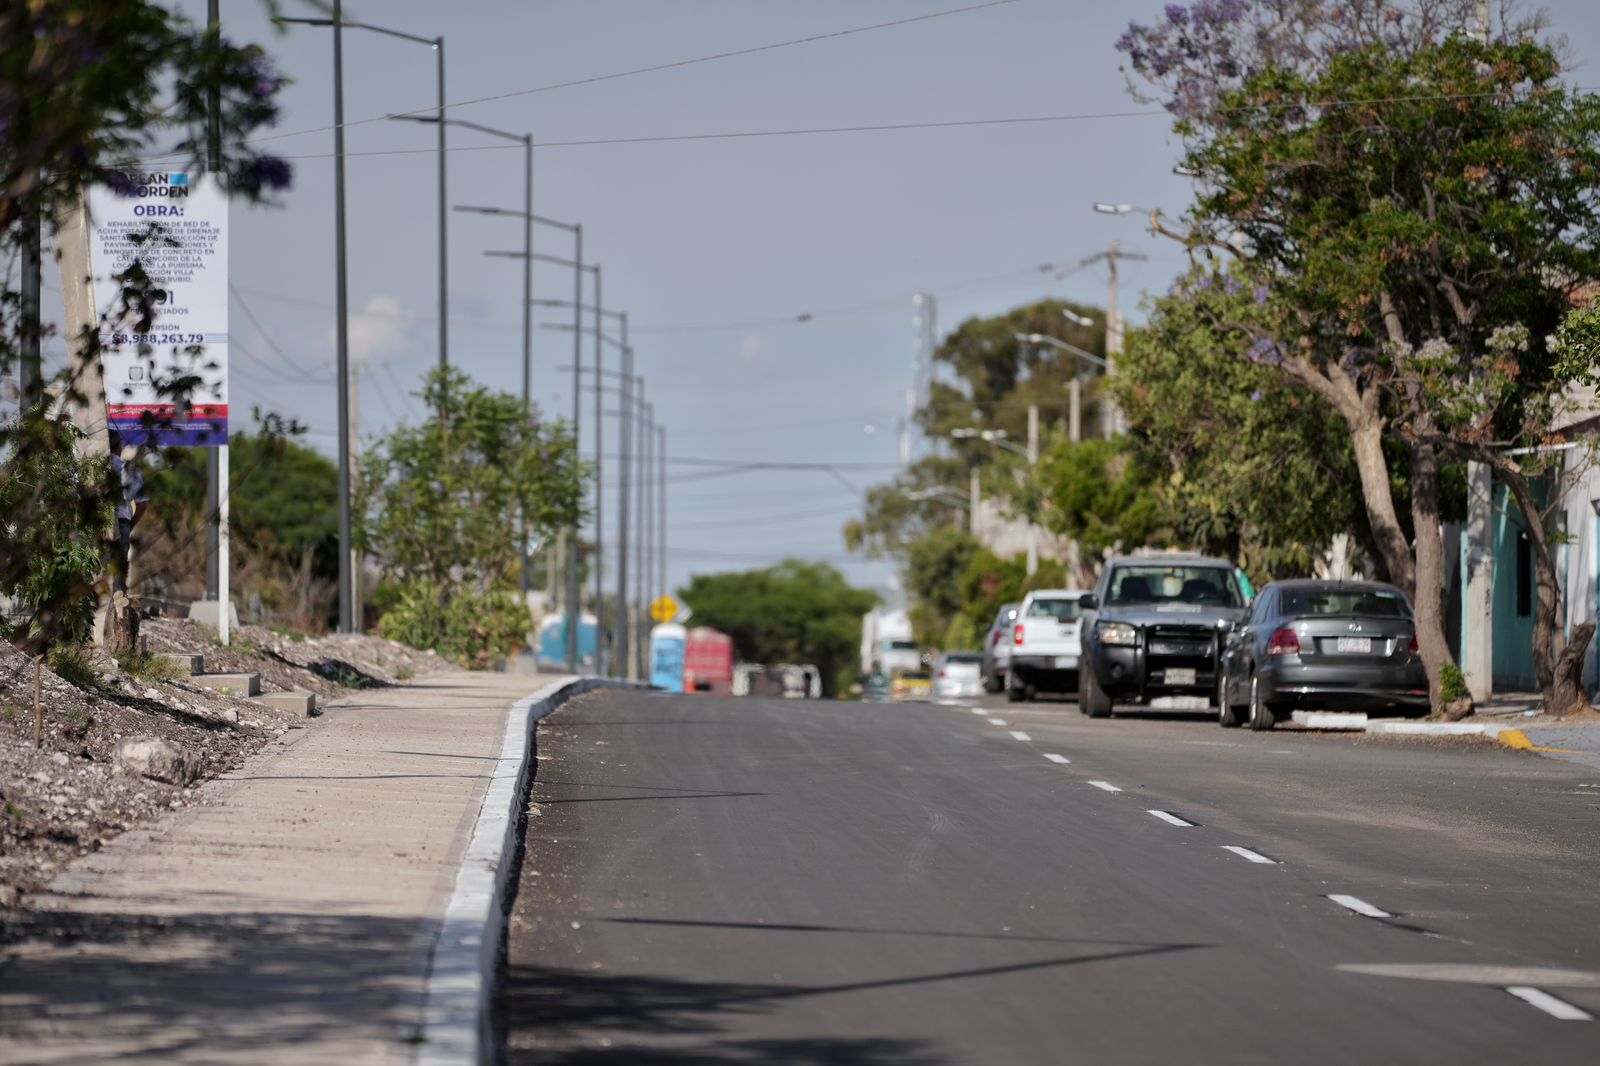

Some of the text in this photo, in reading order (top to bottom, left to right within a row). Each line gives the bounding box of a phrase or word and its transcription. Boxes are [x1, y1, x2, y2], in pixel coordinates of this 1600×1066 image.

[136, 186, 188, 198] ORDEN
[134, 205, 184, 216] OBRA:
[112, 334, 204, 346] $8,988,263.79
